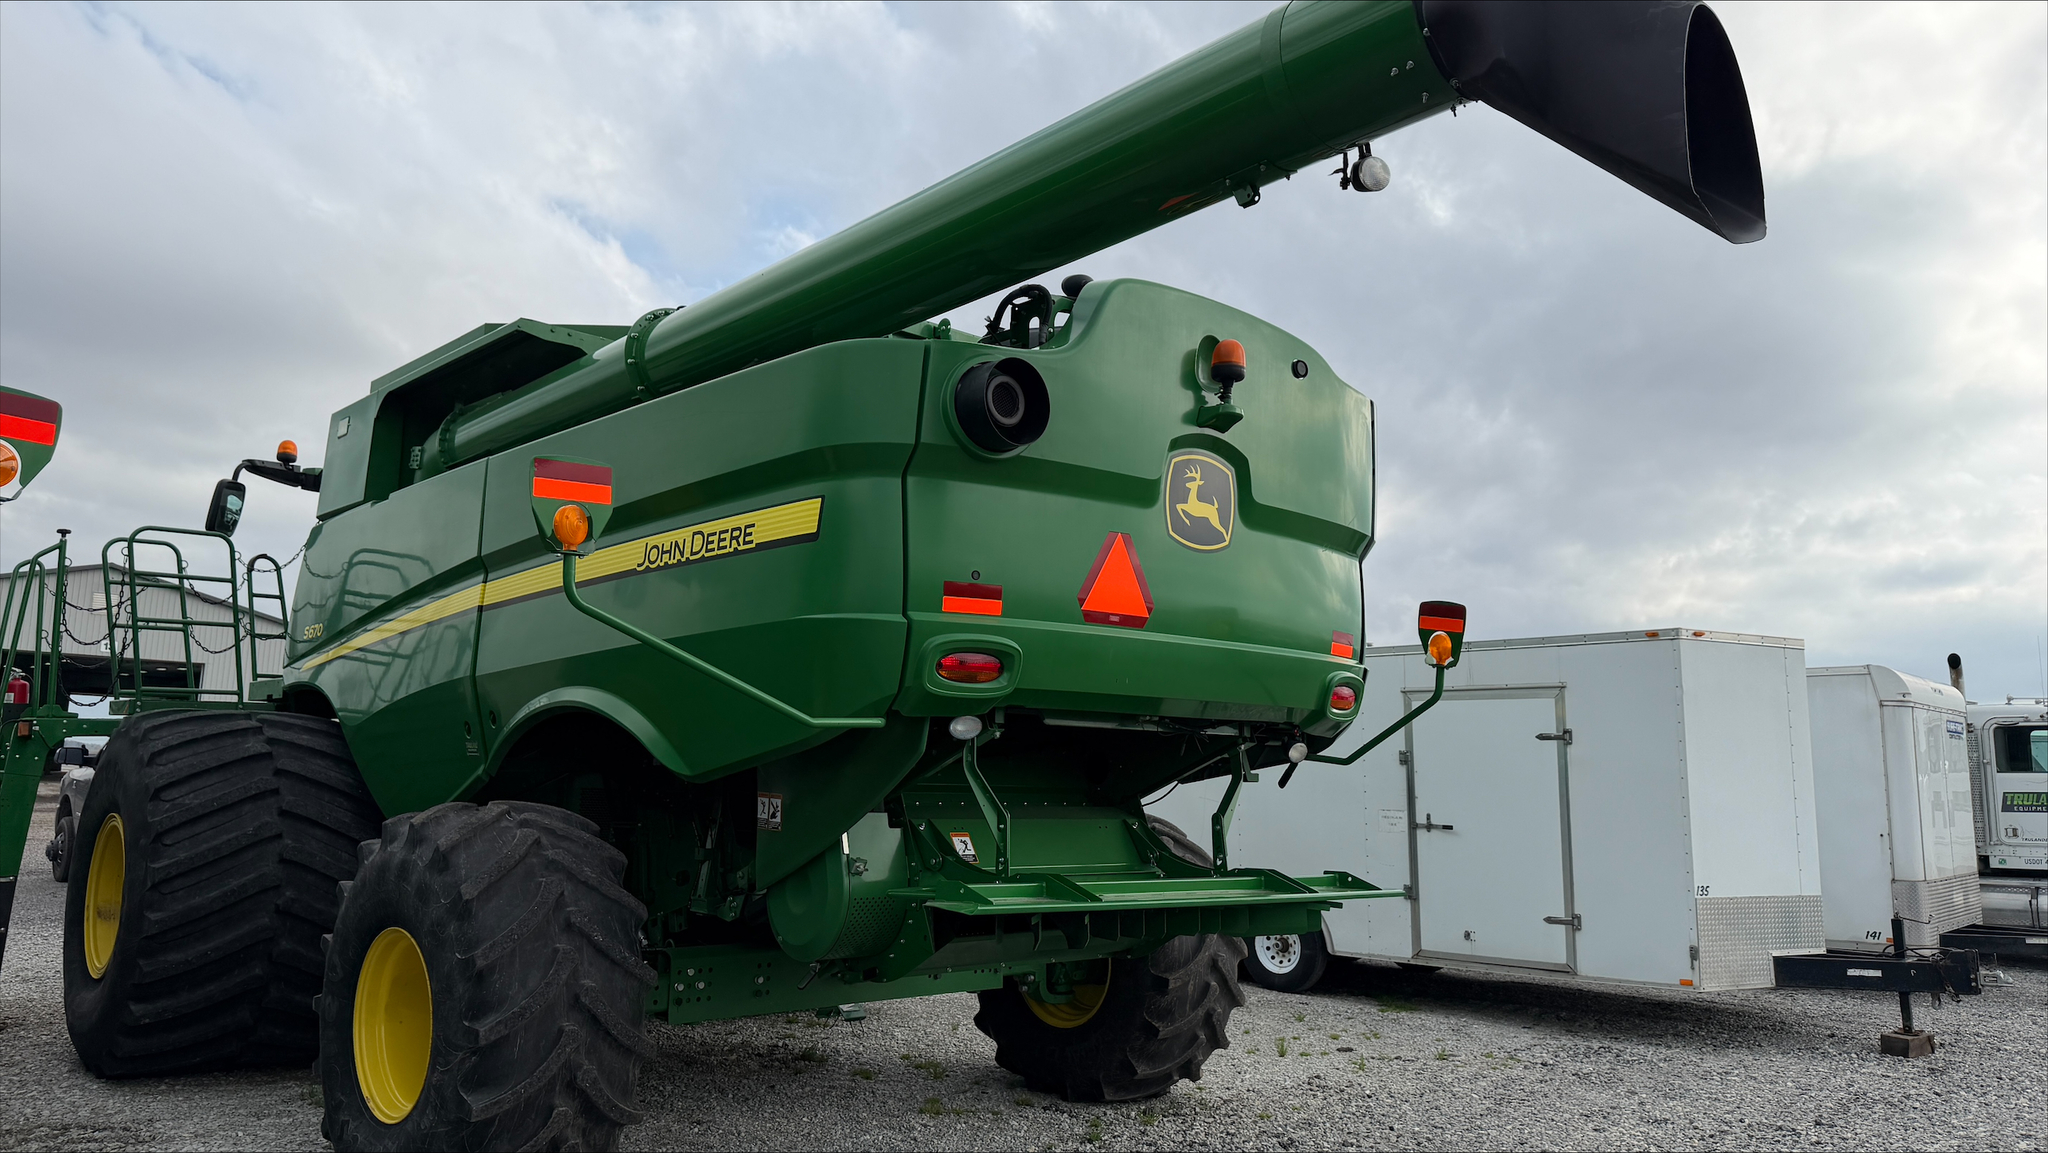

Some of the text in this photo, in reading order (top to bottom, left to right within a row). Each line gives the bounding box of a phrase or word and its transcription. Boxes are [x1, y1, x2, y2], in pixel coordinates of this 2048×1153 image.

[636, 523, 756, 569] JOHN DEERE
[303, 623, 323, 640] S670
[2024, 858, 2043, 866] USDOT
[1695, 885, 1710, 897] 135
[1865, 930, 1882, 941] 141
